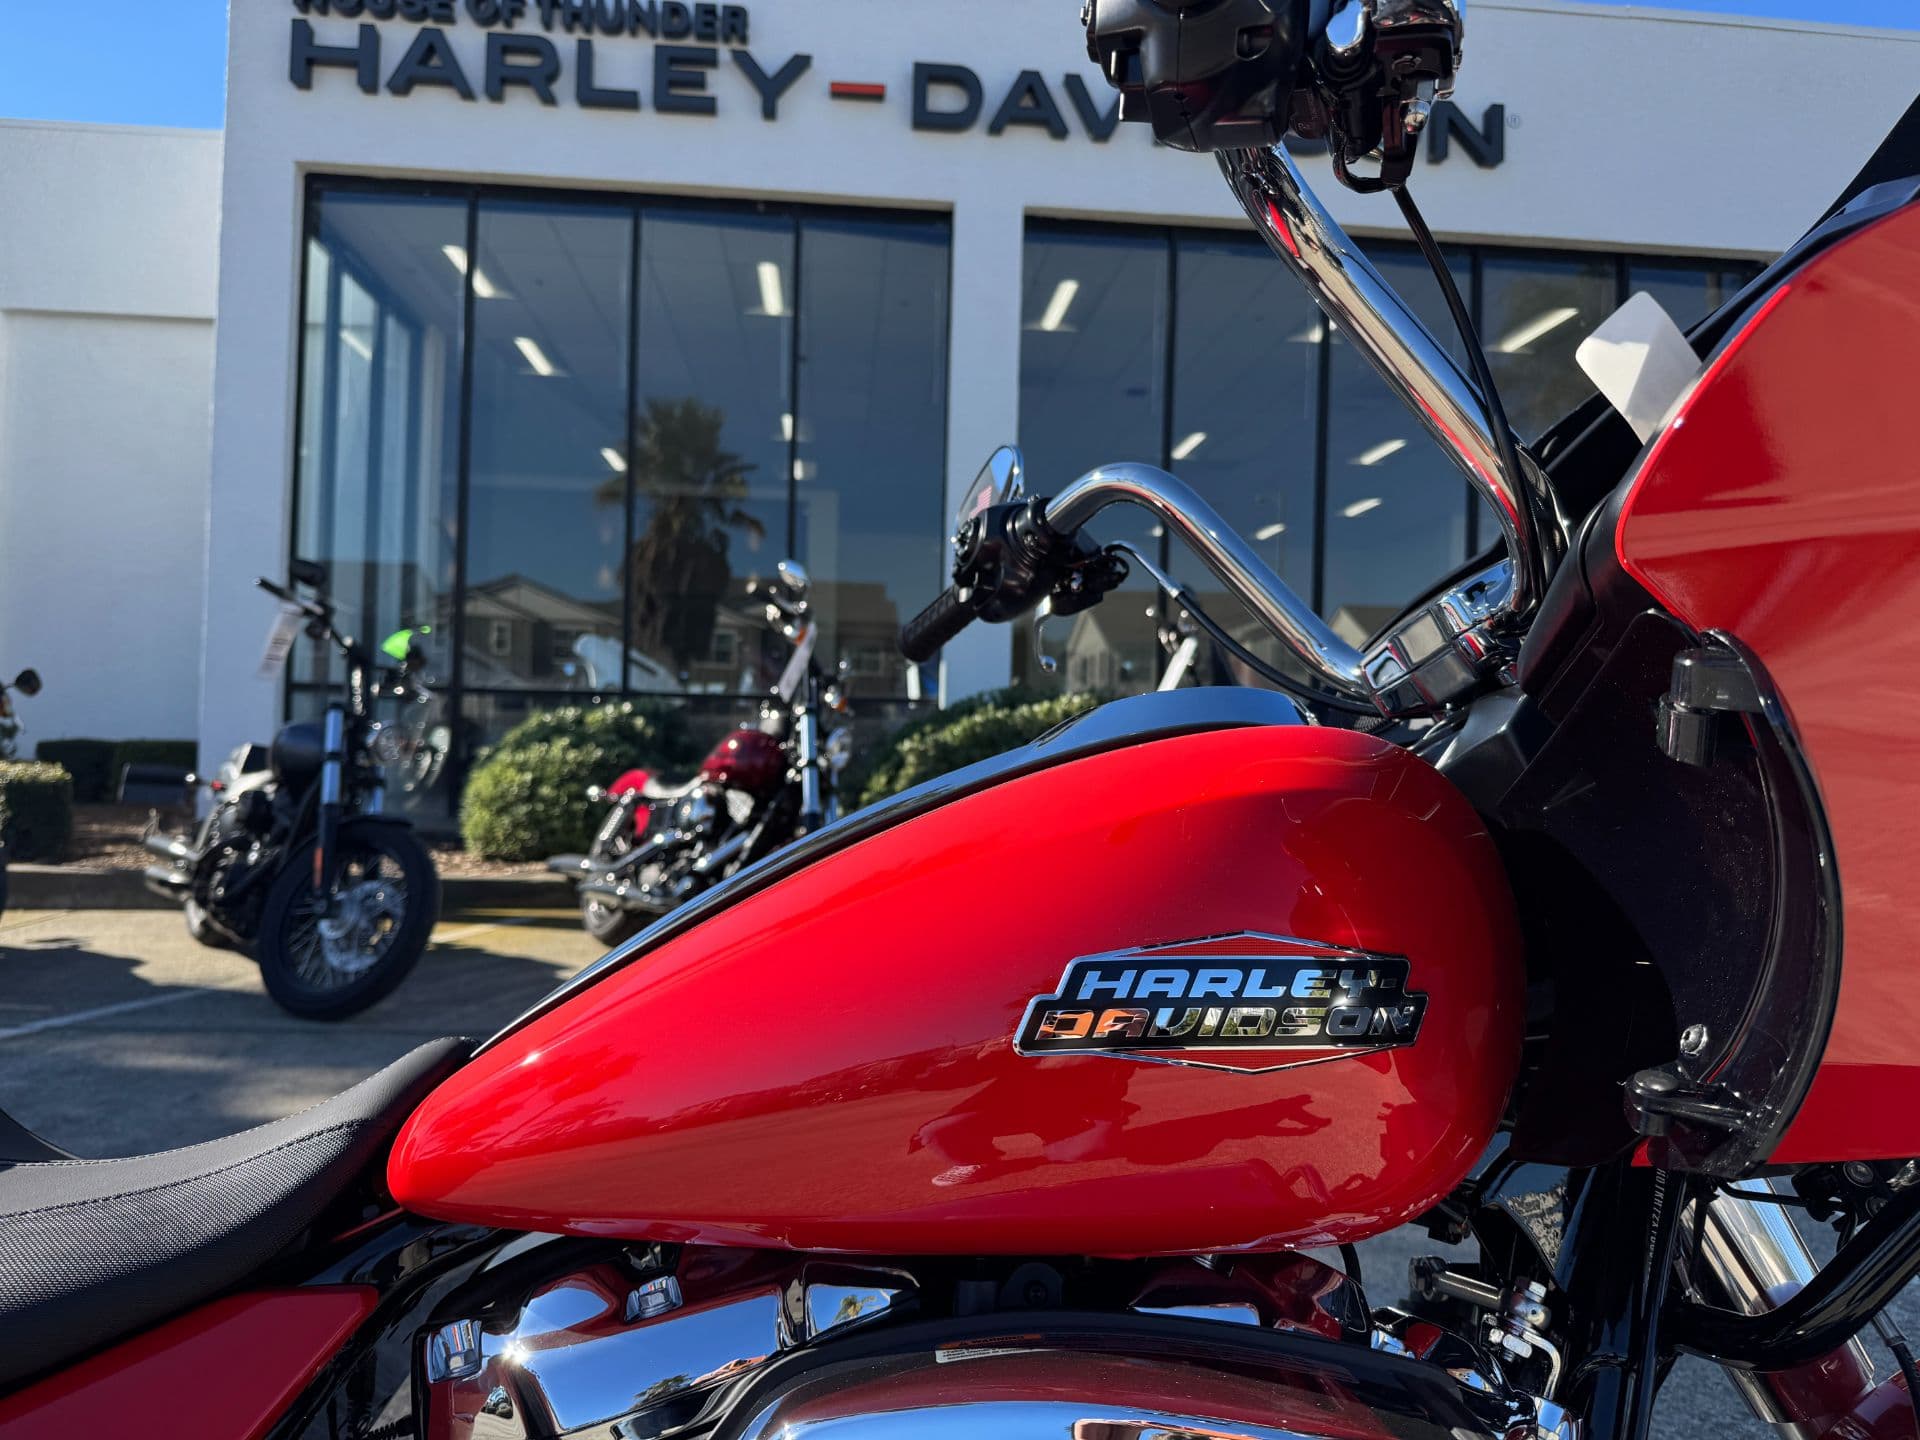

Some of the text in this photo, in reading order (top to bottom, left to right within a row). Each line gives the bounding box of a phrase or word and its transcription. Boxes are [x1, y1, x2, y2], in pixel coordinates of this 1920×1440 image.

[464, 0, 527, 29] OF
[533, 0, 748, 46] THUNDER
[1035, 1005, 1414, 1041] DAVIDSON
